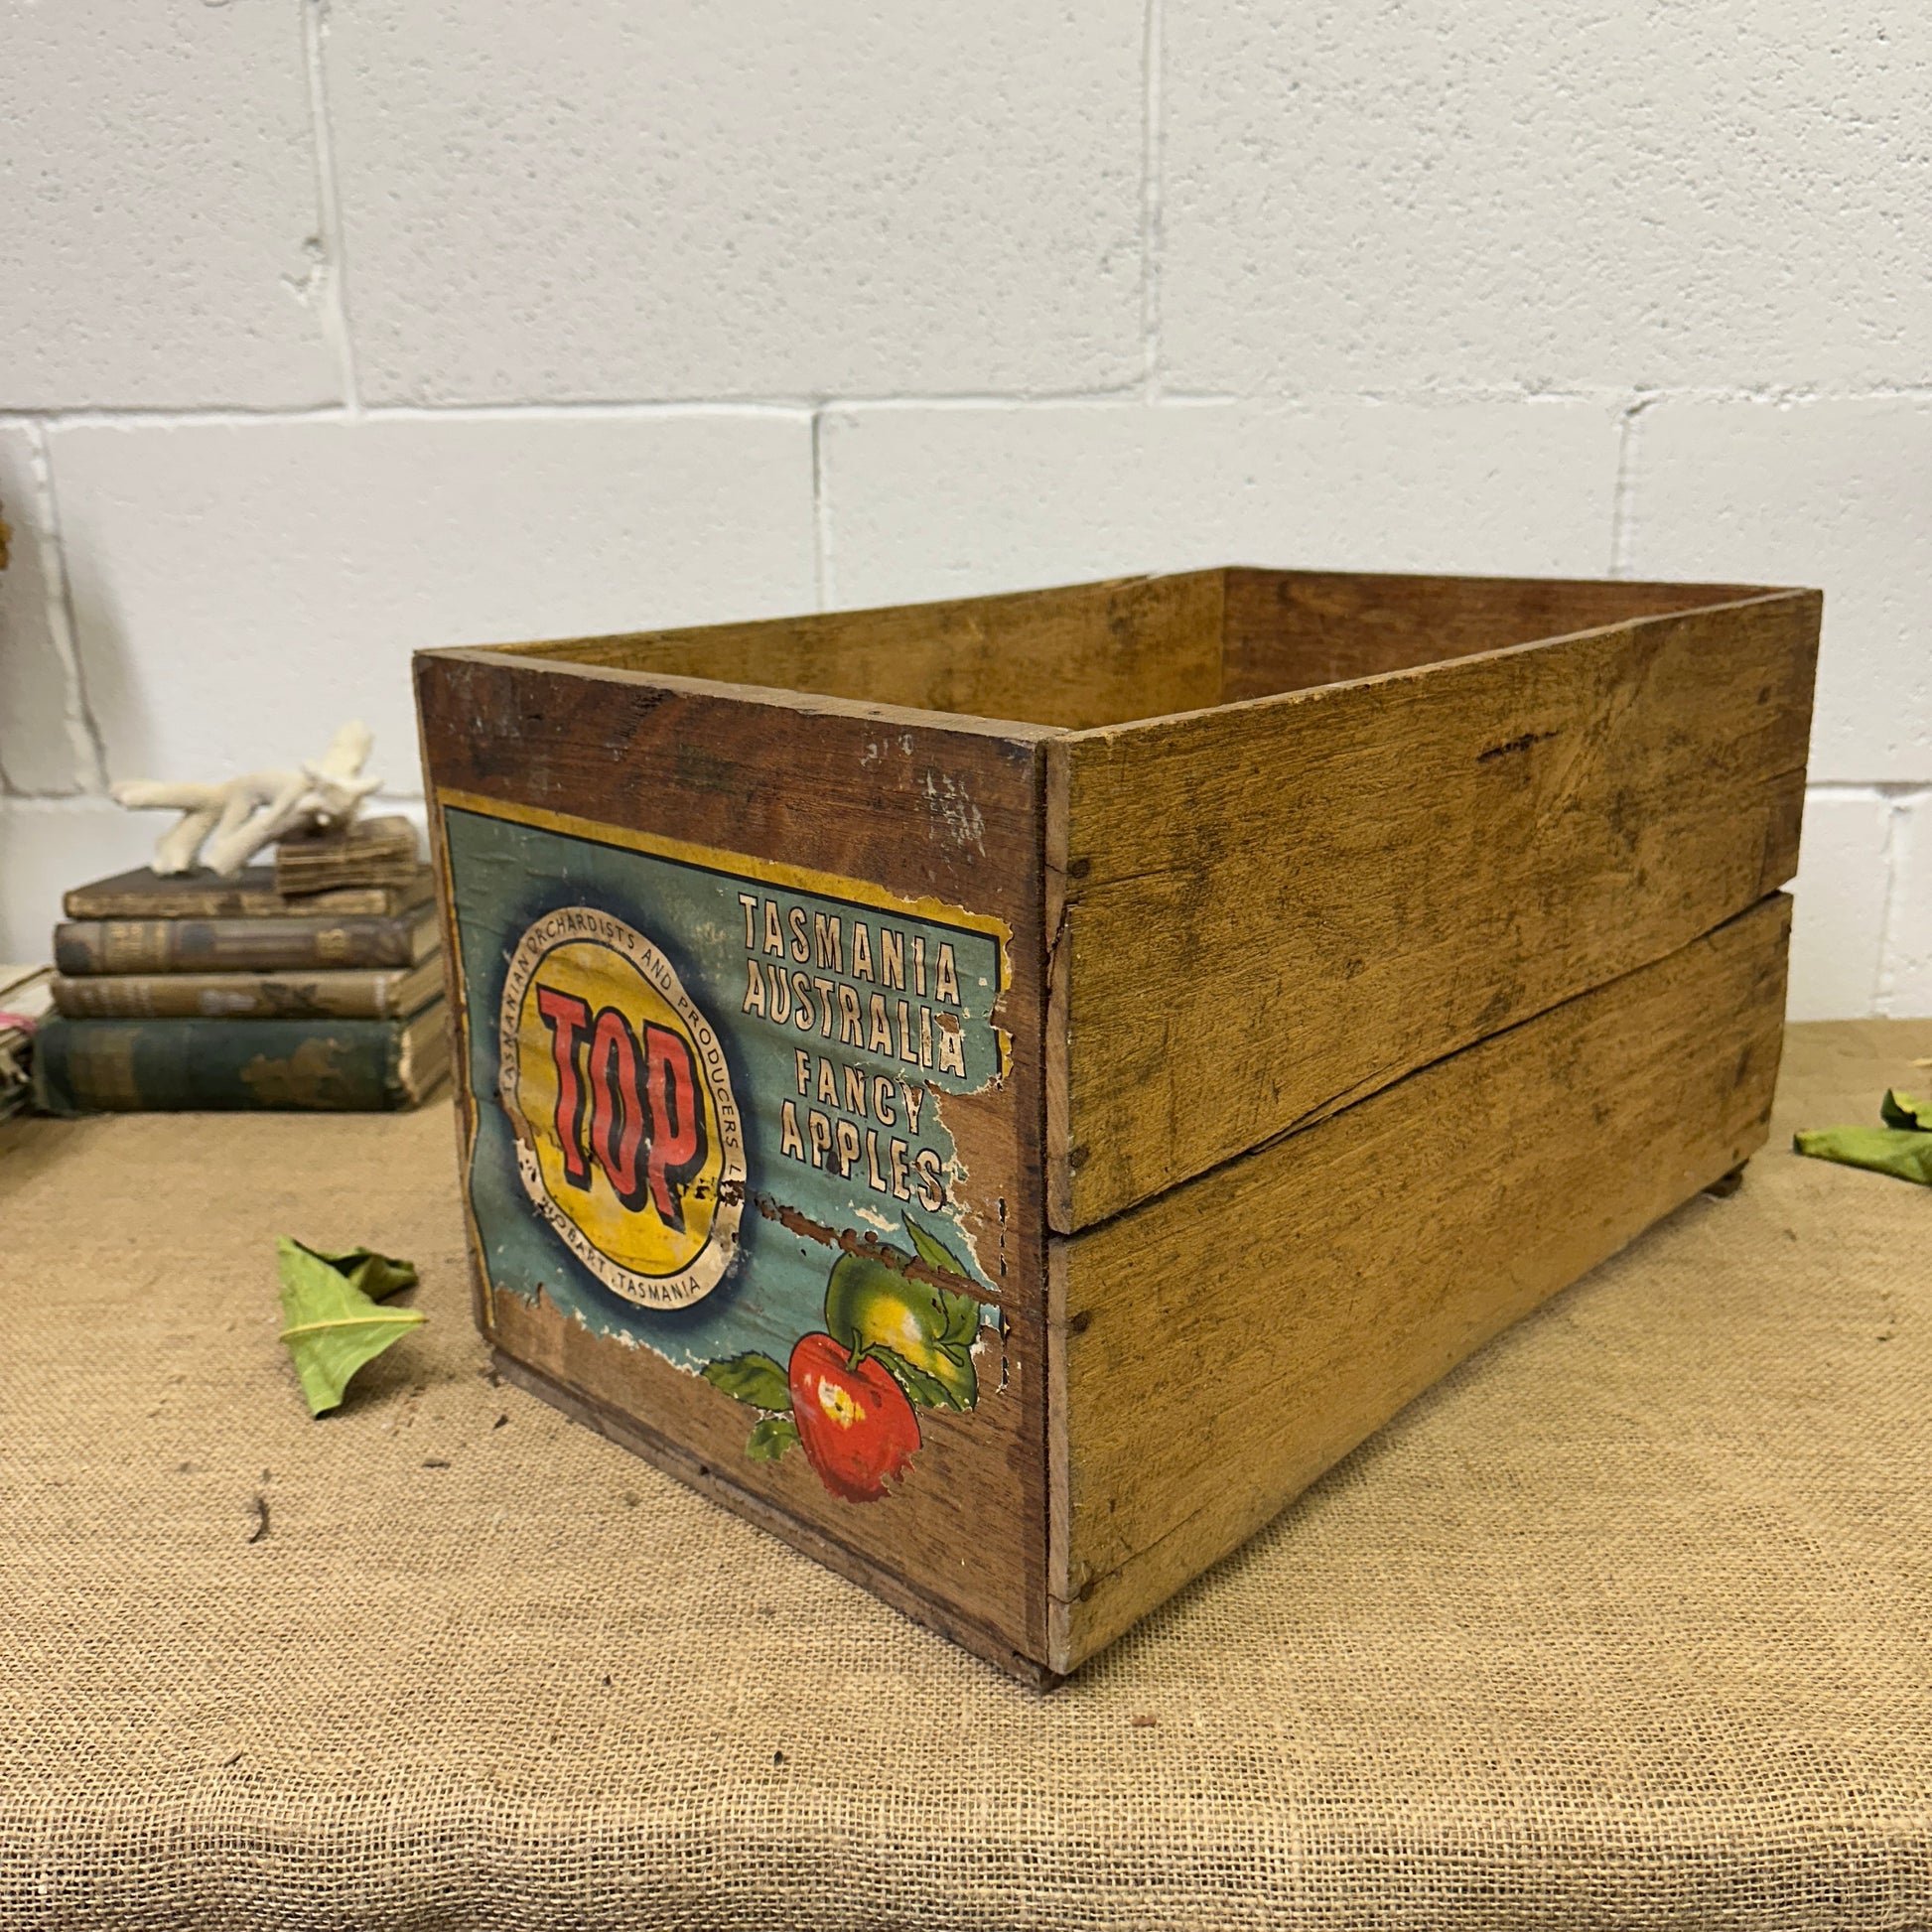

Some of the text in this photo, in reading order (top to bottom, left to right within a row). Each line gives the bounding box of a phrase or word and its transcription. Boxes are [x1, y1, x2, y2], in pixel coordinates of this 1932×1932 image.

[739, 893, 962, 1007] TASMANIA
[501, 913, 741, 1148] TASMANIAN ORCHARDISTS AND PRODUCERS
[742, 958, 967, 1079] AUSTRALIA
[535, 983, 708, 1234] TOP
[794, 1047, 924, 1135] FANCY
[779, 1099, 948, 1213] APPLES
[617, 1272, 701, 1303] TASMANIA
